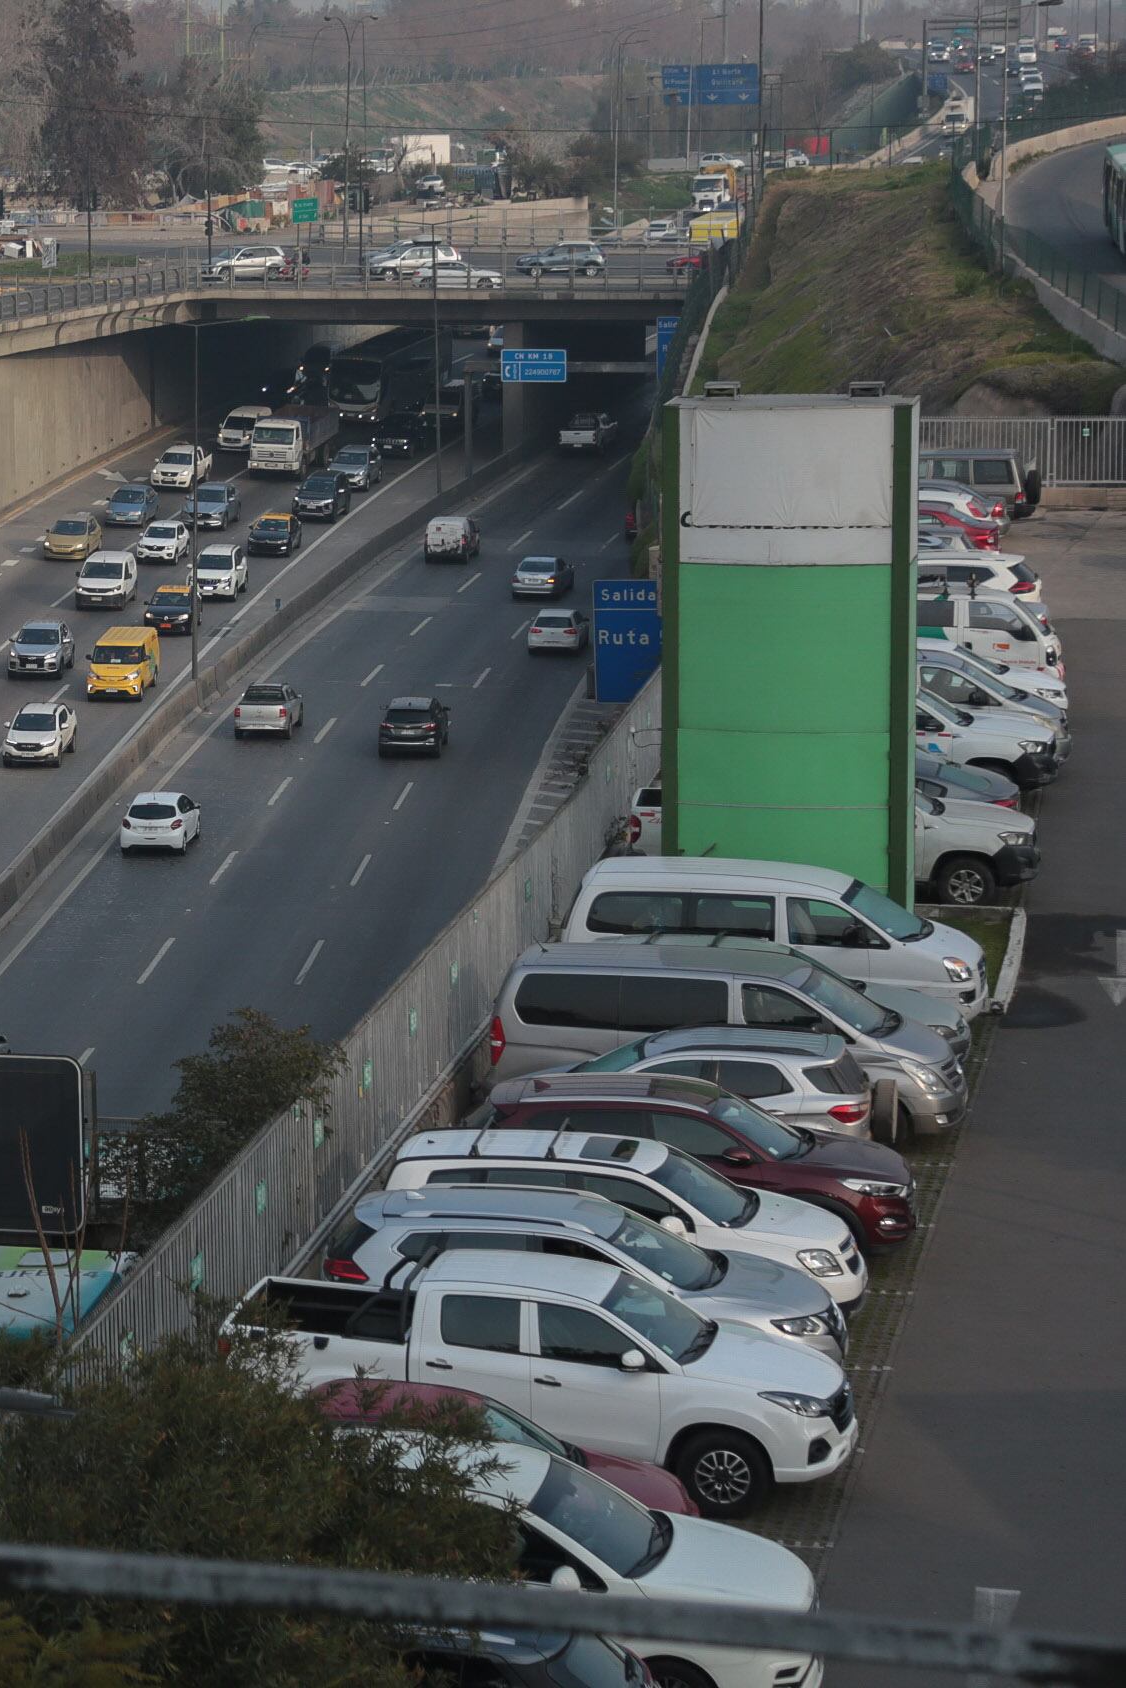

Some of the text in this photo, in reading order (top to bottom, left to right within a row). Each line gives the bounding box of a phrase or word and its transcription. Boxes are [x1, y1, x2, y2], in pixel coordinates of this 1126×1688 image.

[528, 352, 539, 360] KM
[601, 588, 656, 601] Salida
[598, 628, 650, 645] Ruta
